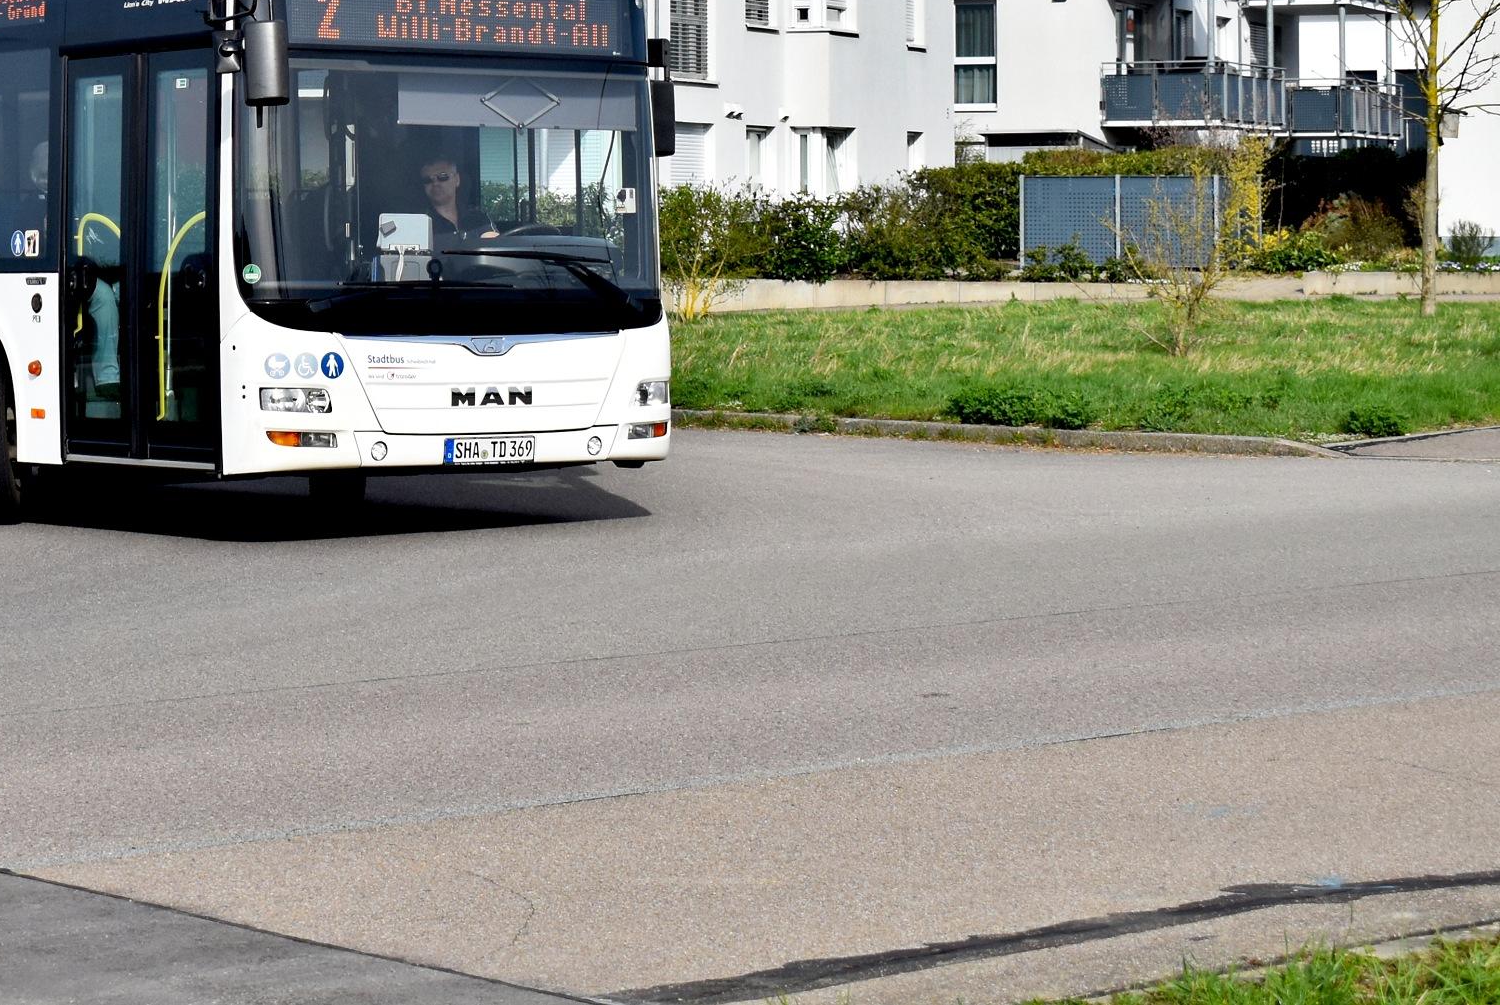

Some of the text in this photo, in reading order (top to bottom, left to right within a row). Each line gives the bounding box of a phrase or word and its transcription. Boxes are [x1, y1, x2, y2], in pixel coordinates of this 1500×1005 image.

[141, 0, 155, 7] City
[367, 353, 405, 364] Stadtbus
[451, 386, 533, 407] MAN
[455, 439, 533, 459] SHA TD 369
